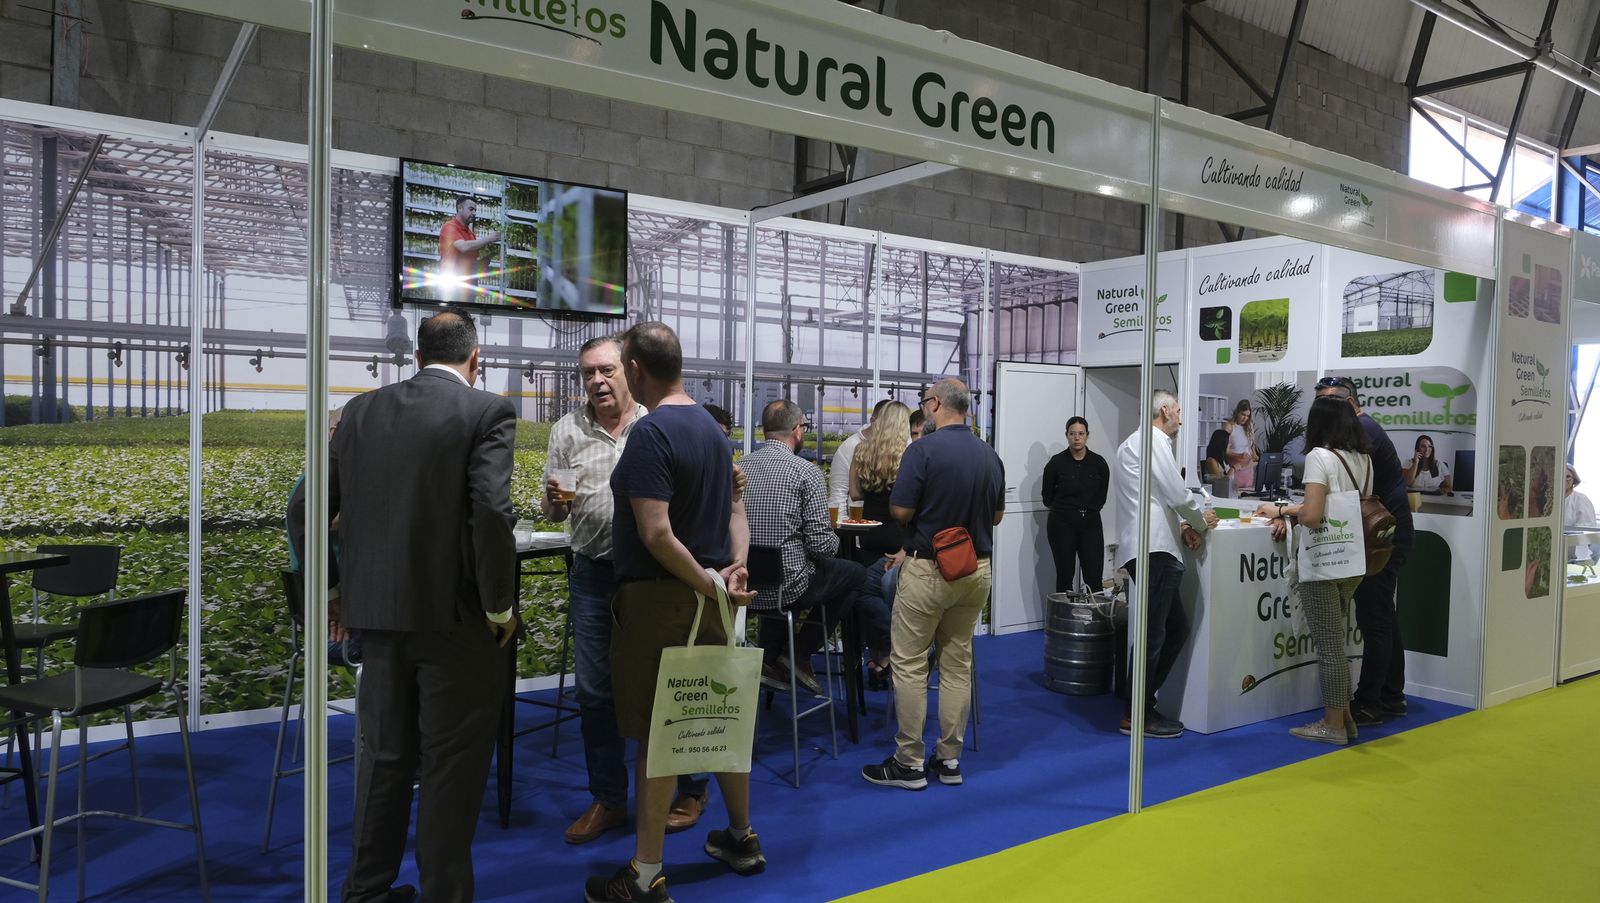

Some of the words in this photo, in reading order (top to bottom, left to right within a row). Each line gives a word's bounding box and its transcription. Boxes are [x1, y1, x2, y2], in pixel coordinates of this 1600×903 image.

[650, 0, 893, 117] Natural
[911, 72, 1056, 154] Green
[1201, 156, 1261, 189] Cultivando
[1265, 167, 1304, 193] calidad
[1340, 183, 1361, 197] Natural
[1344, 195, 1361, 207] Green
[1198, 266, 1260, 296] Cultivando
[1266, 255, 1314, 282] calidad
[1097, 285, 1139, 300] Natural
[1105, 302, 1139, 314] Green
[1113, 315, 1172, 328] Semilros
[1511, 351, 1536, 366] Natural
[1349, 372, 1412, 389] atural
[1516, 368, 1535, 381] Green
[1520, 385, 1551, 398] Semilleros
[1357, 394, 1411, 407] Green
[1312, 532, 1354, 544] Semilleros
[1240, 552, 1291, 583] Natu
[1257, 592, 1291, 622] Gre
[667, 676, 709, 688] Natural
[674, 691, 708, 702] Green
[681, 704, 740, 716] Semilleros
[688, 746, 701, 754] 950
